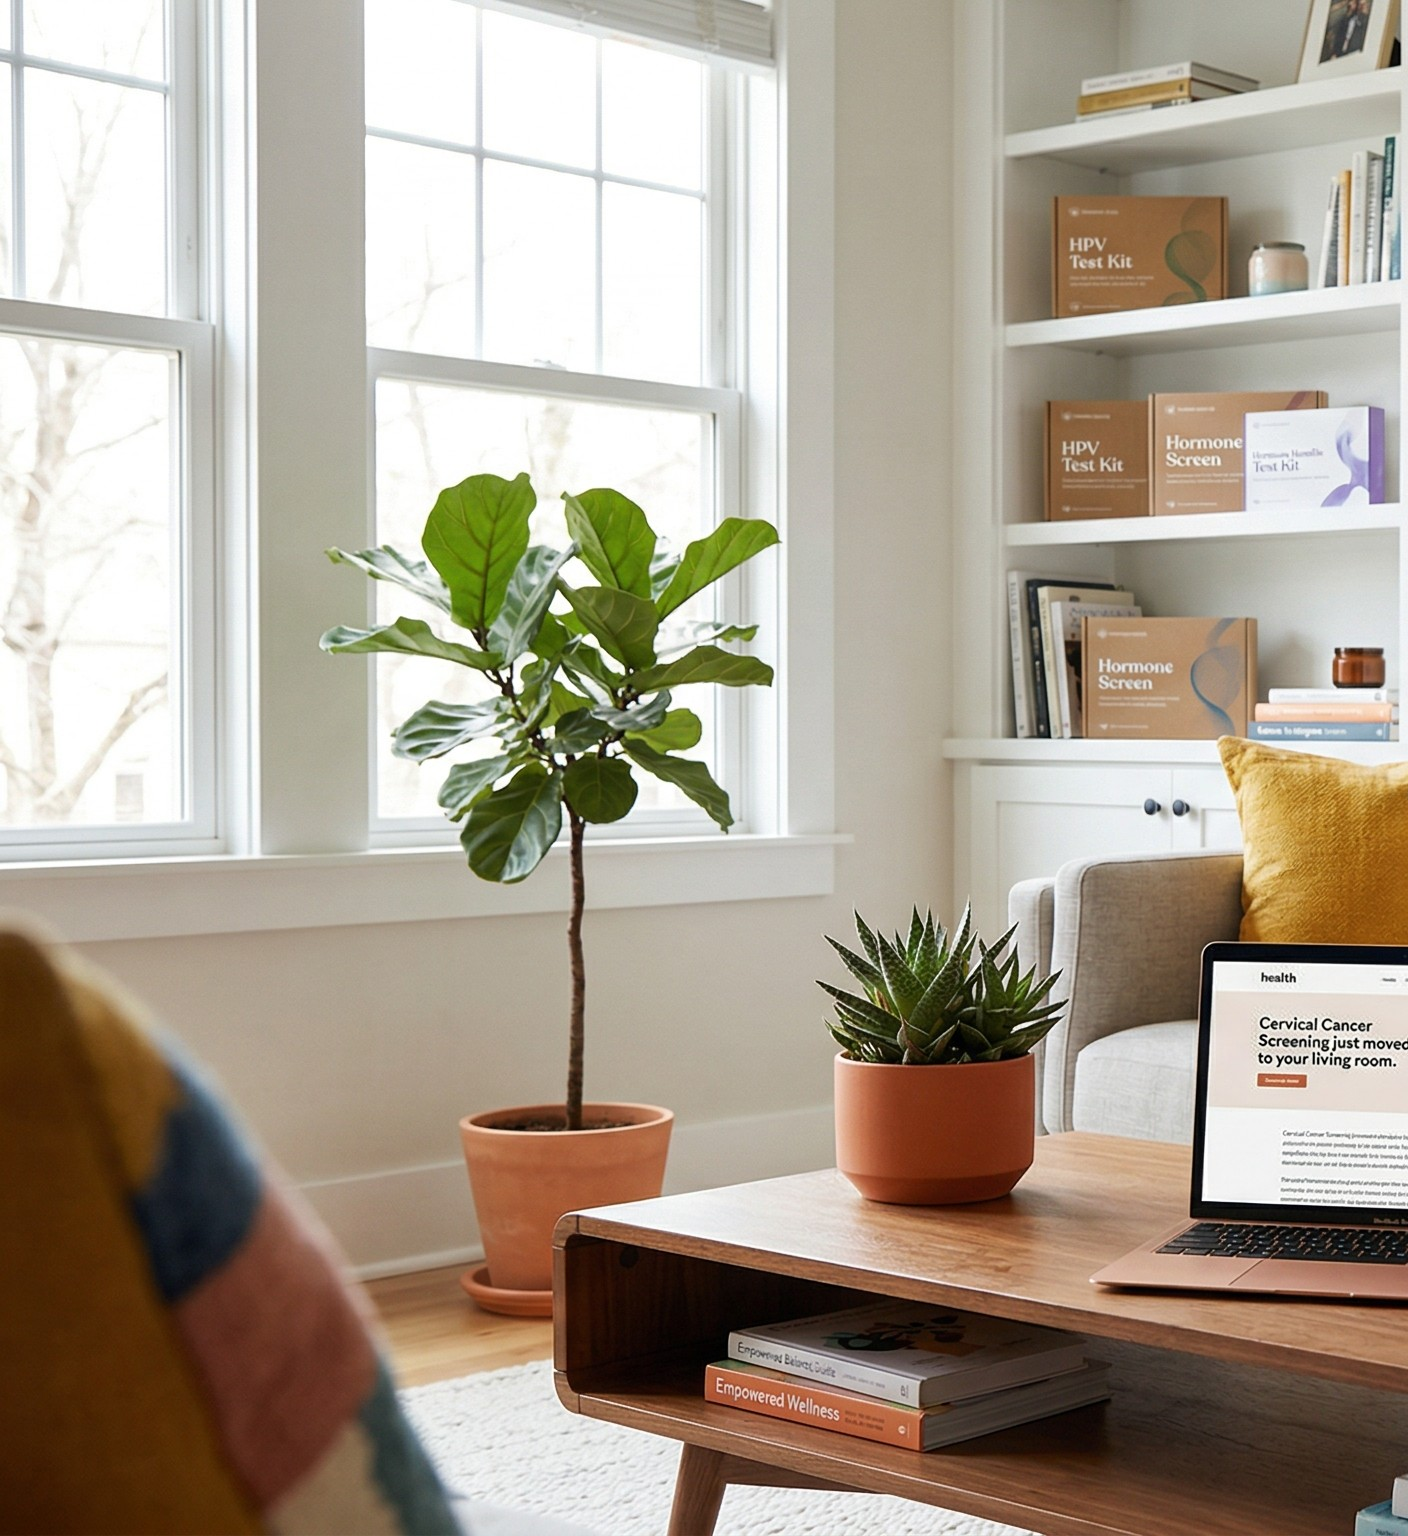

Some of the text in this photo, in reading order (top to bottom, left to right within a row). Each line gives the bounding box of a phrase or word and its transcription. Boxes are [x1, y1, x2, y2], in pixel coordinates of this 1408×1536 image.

[1069, 237, 1107, 252] HPV
[1069, 254, 1133, 269] Test Kit
[1062, 441, 1100, 456] HPV
[1166, 435, 1243, 450] Hormone
[1062, 457, 1124, 472] Test Kit
[1166, 452, 1222, 467] Screen
[1098, 658, 1174, 674] Hormone
[1098, 675, 1153, 690] Screen
[1261, 972, 1297, 983] health
[1259, 1016, 1373, 1032] Cervical Cancer
[1258, 1034, 1330, 1051] Screening
[1332, 1035, 1360, 1052] just
[1258, 1051, 1397, 1070] to your living room.
[716, 1377, 785, 1408] Empowered
[787, 1394, 841, 1422] Wellness
